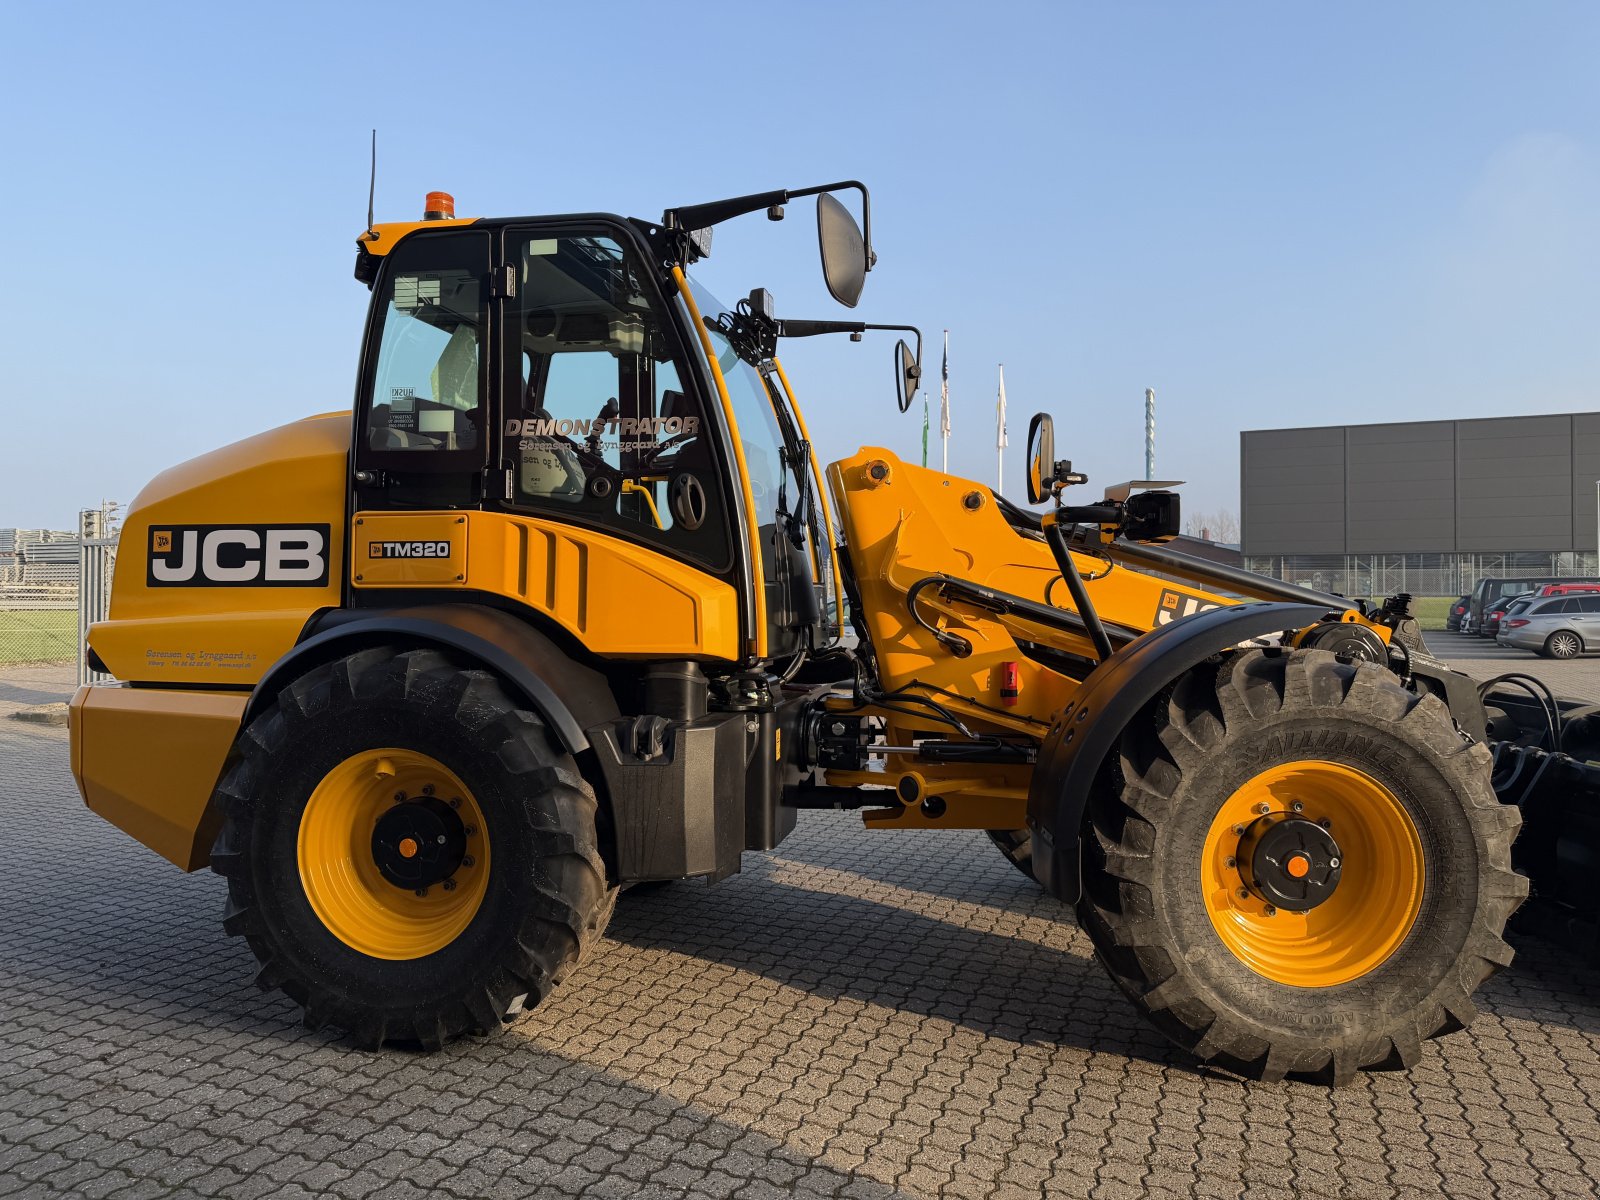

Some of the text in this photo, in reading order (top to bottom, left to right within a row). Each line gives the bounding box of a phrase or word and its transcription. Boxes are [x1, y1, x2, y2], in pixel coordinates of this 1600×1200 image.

[504, 416, 701, 437] DEMONSTRATOR
[576, 441, 592, 454] og
[596, 437, 661, 453] Lynggaard
[152, 529, 325, 582] JCB
[383, 542, 449, 557] TM320
[1260, 729, 1407, 772] ALLIANCE
